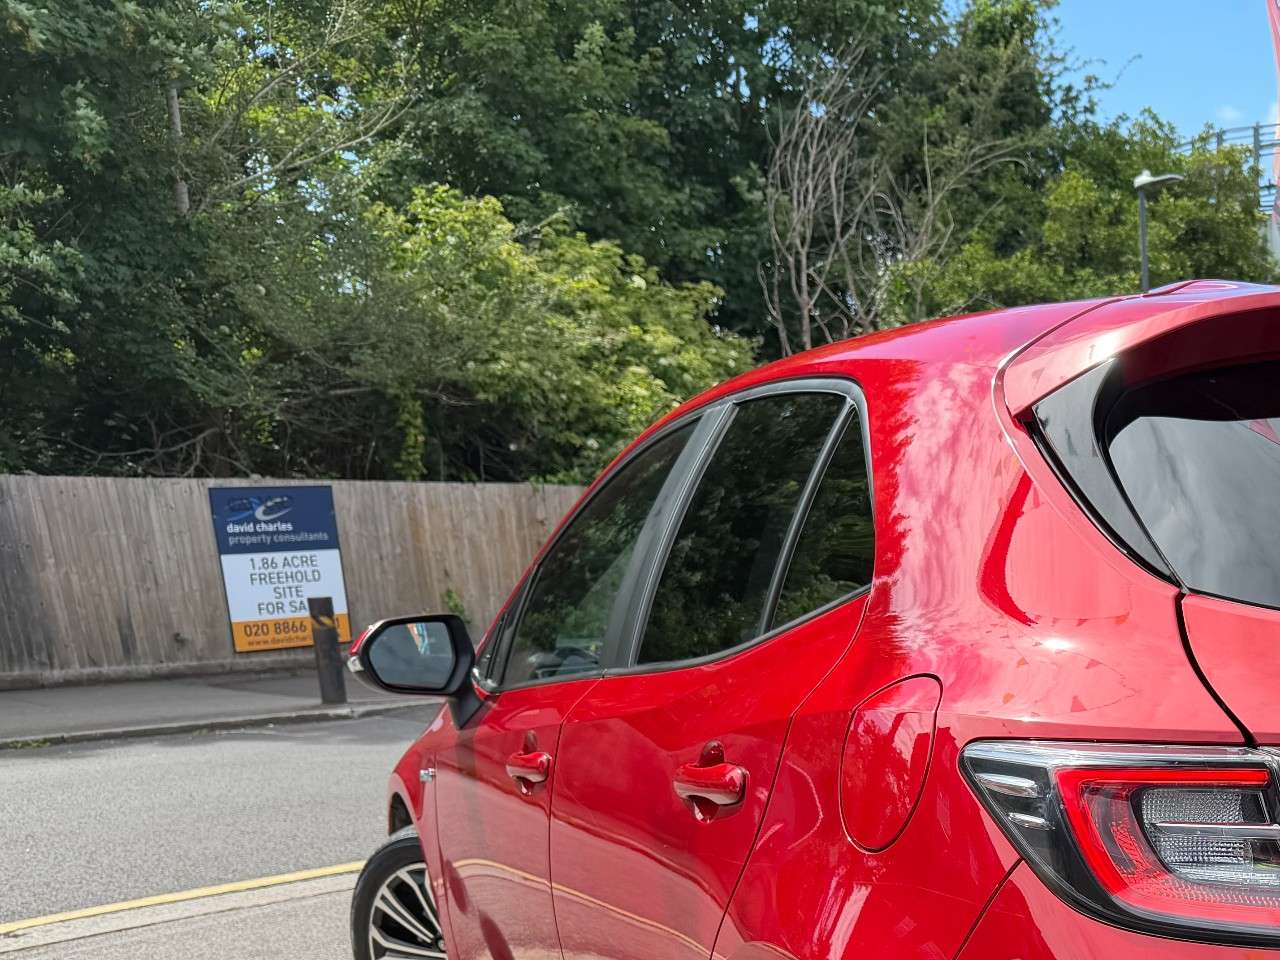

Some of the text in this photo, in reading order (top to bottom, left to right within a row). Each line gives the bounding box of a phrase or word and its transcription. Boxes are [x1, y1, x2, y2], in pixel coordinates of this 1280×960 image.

[226, 520, 293, 534] david charles
[228, 532, 329, 546] property consultants
[250, 555, 318, 570] 1.86 ACRE
[250, 570, 321, 585] FREEHOLD
[273, 586, 304, 599] SITE
[257, 600, 308, 615] FOR SA
[243, 620, 307, 637] 020 8866
